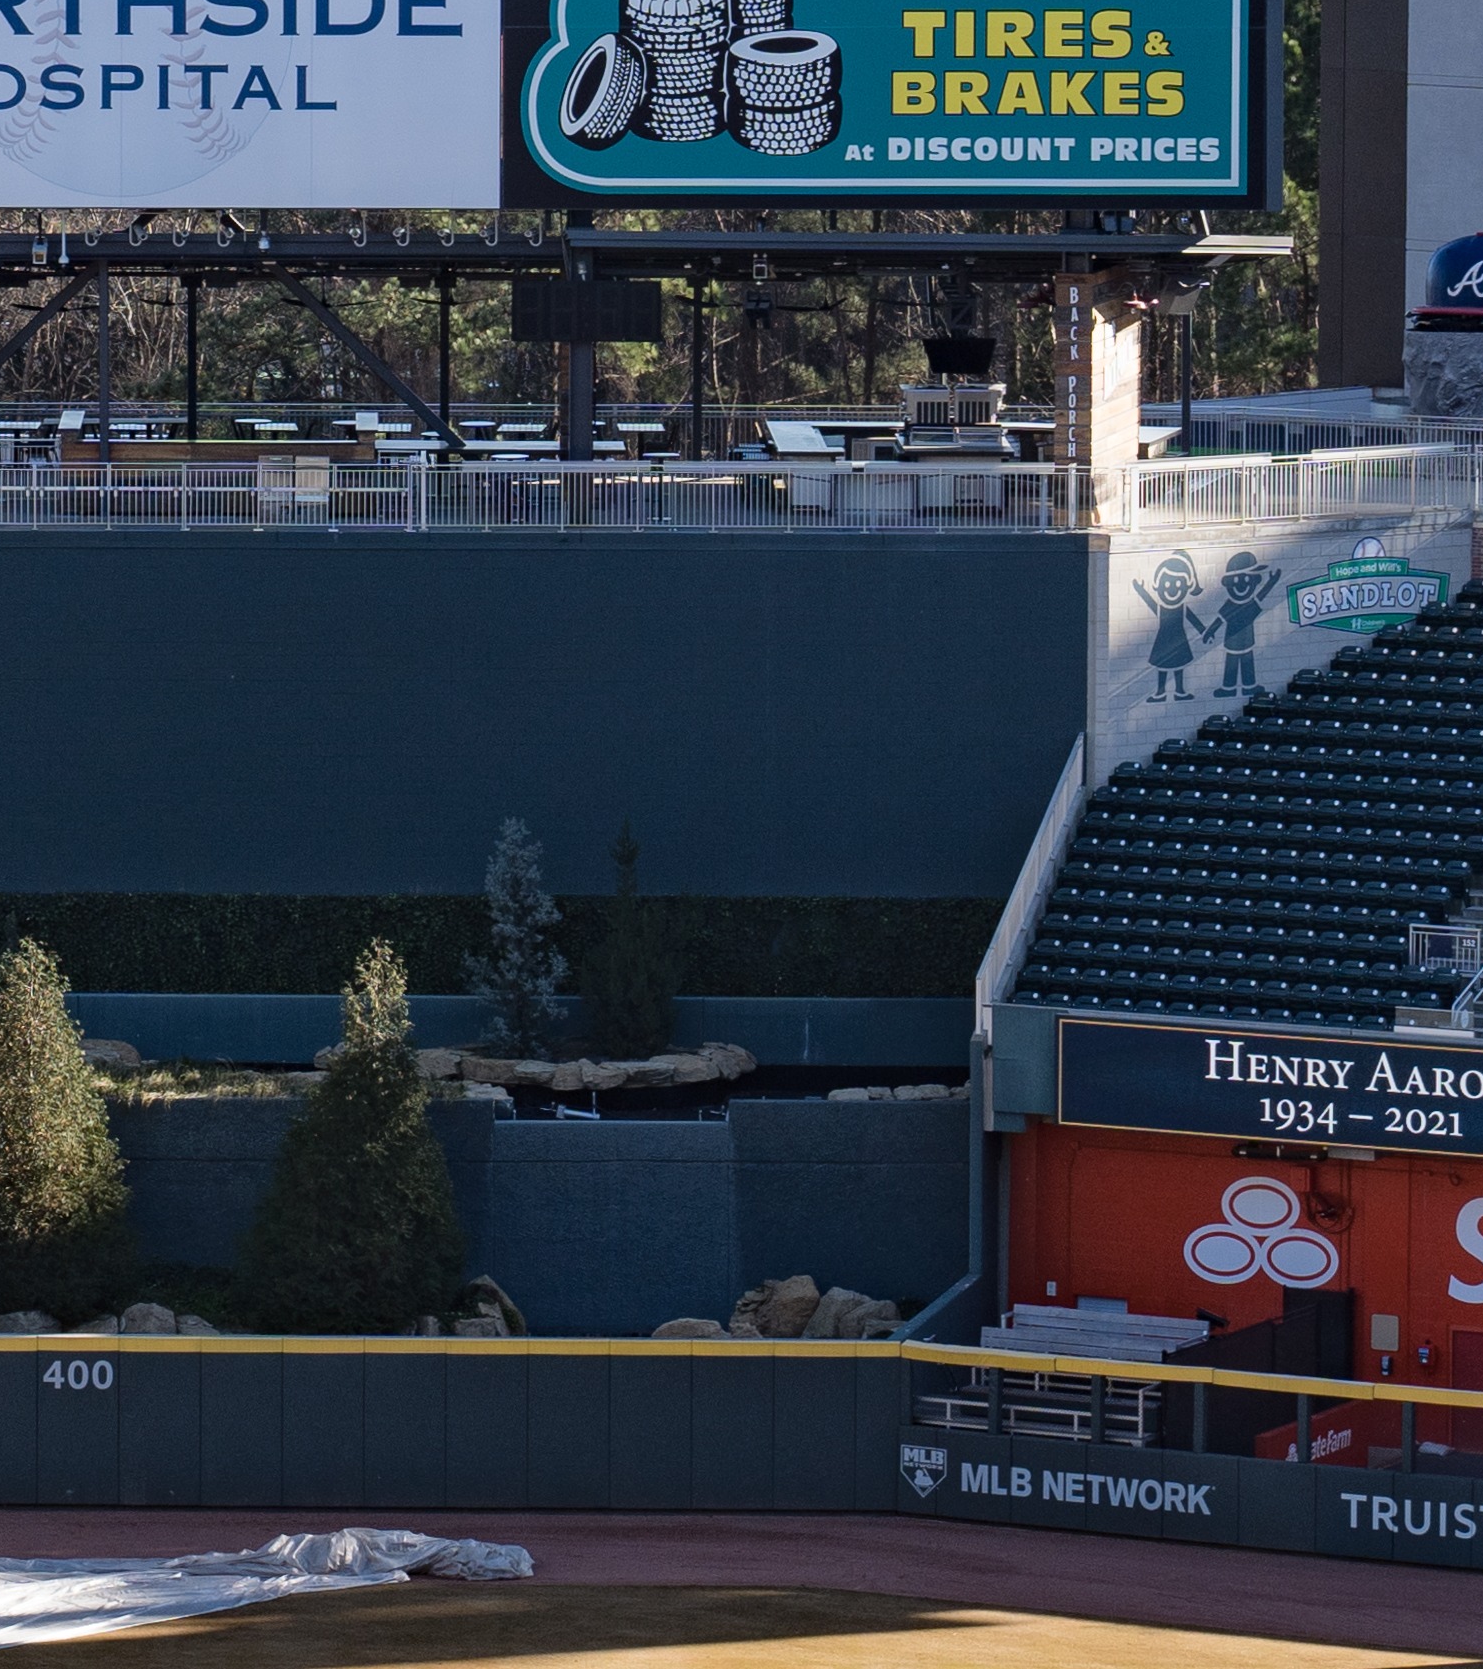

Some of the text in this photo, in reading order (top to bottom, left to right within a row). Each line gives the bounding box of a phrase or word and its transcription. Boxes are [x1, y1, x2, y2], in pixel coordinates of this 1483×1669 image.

[901, 8, 1172, 59] TIRES &
[890, 70, 1187, 118] BRAKES
[888, 136, 1077, 162] DISCOUNT
[1089, 136, 1221, 163] PRICES
[1067, 286, 1079, 458] BACK PORCH
[1335, 565, 1359, 577] Hope
[1360, 564, 1377, 573] and
[1302, 582, 1436, 619] SANDLOT
[1205, 1037, 1355, 1090] HENRY
[1259, 1096, 1336, 1135] 1934
[1384, 1106, 1465, 1138] 2021
[43, 1359, 115, 1391] 400
[902, 1447, 944, 1465] MLB
[960, 1462, 1212, 1515] MLB NETWORK
